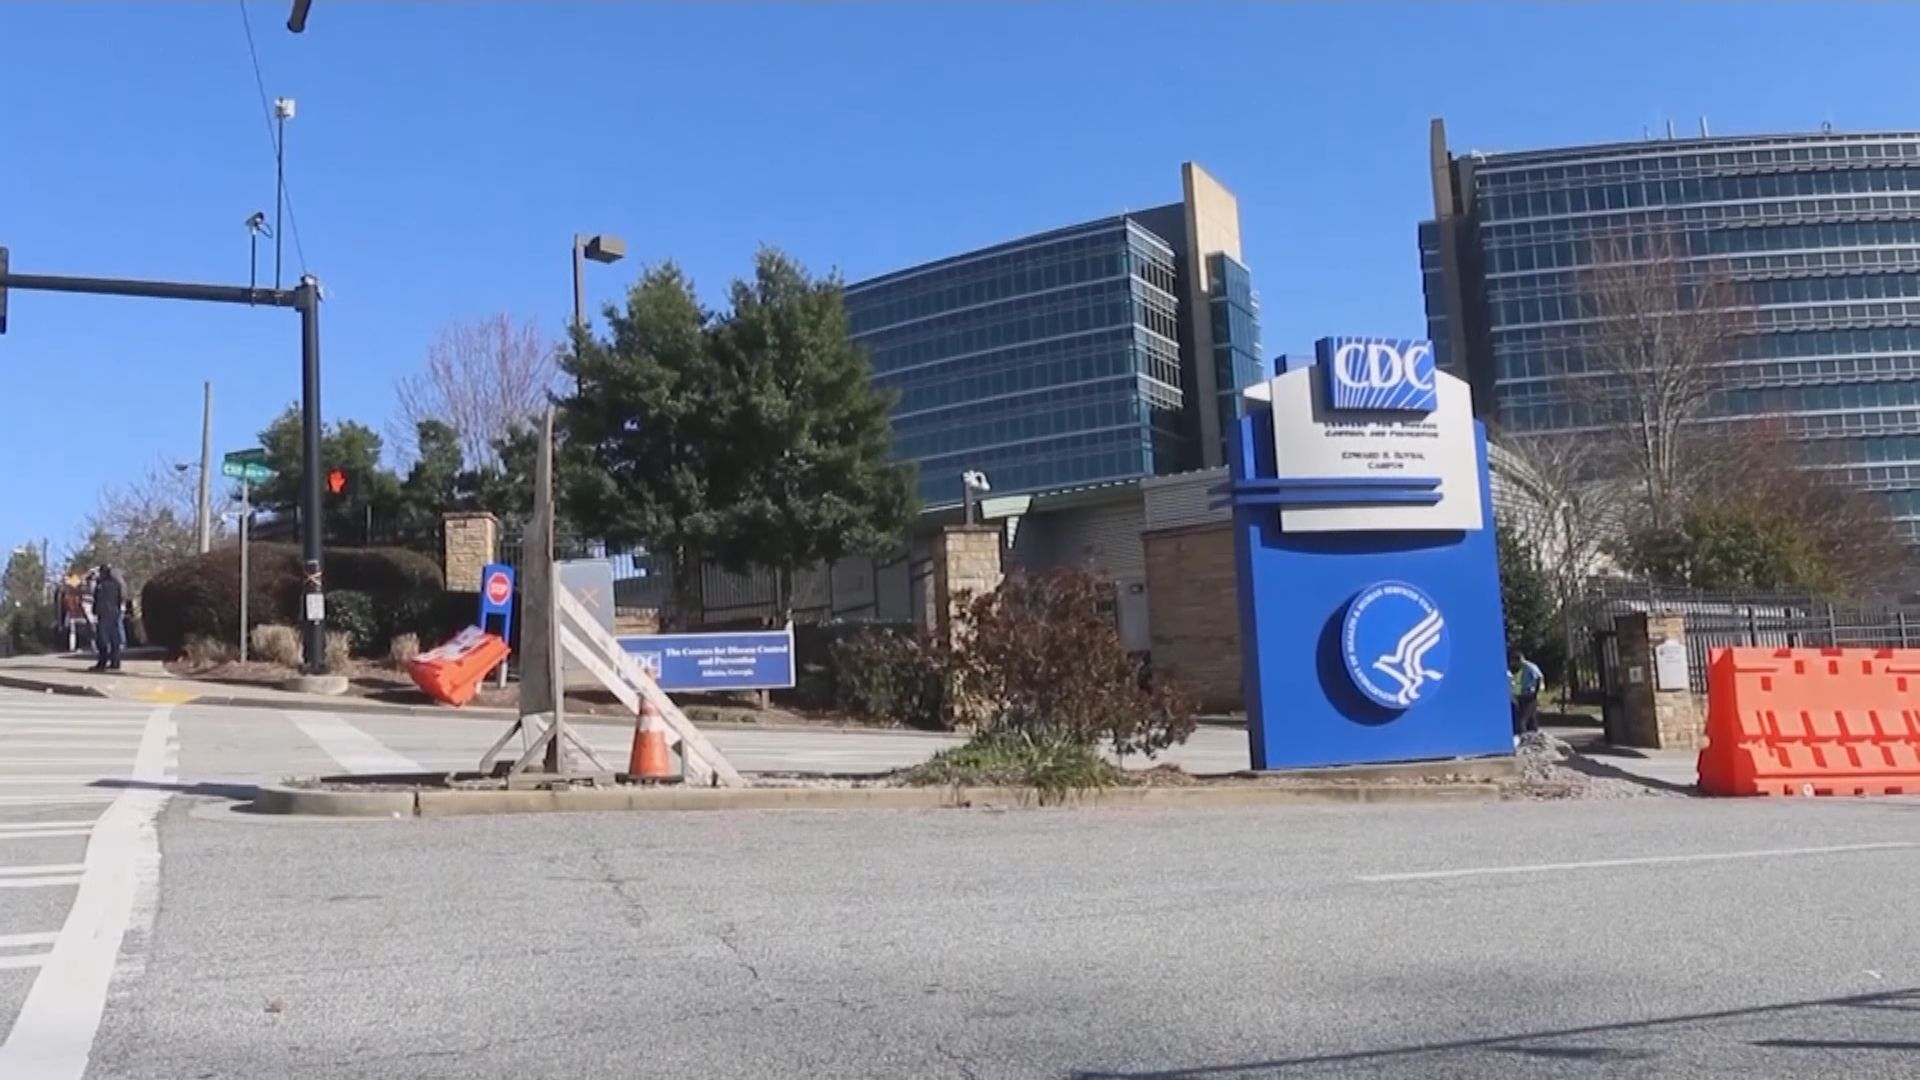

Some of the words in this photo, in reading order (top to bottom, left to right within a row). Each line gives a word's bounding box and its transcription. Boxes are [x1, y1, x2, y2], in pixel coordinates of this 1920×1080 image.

[1335, 343, 1433, 390] CDC
[666, 648, 680, 656] The
[682, 647, 712, 656] Centers
[758, 644, 788, 653] Control
